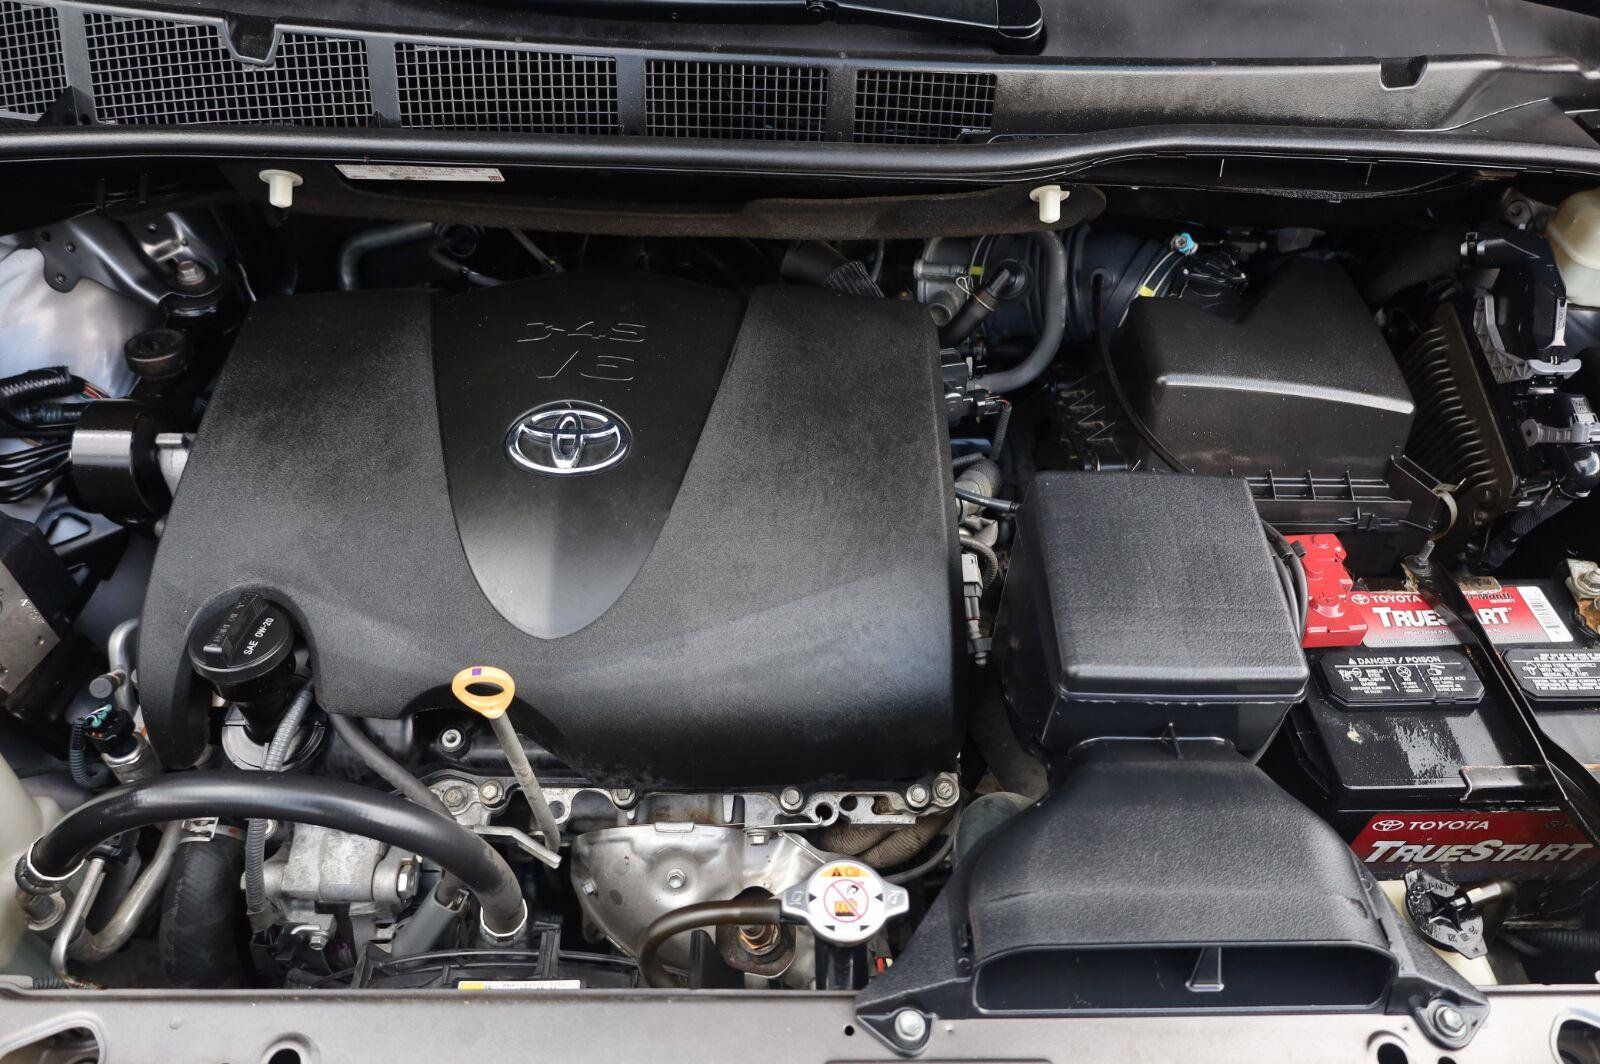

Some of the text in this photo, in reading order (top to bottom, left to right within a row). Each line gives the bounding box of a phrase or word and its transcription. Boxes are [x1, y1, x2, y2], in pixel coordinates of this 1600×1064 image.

[1369, 594, 1422, 604] TOYOTA
[243, 617, 274, 656] SAE 0W-20
[1356, 657, 1397, 665] DANGER
[1404, 655, 1442, 663] POISON
[1408, 820, 1489, 831] TOYOTA
